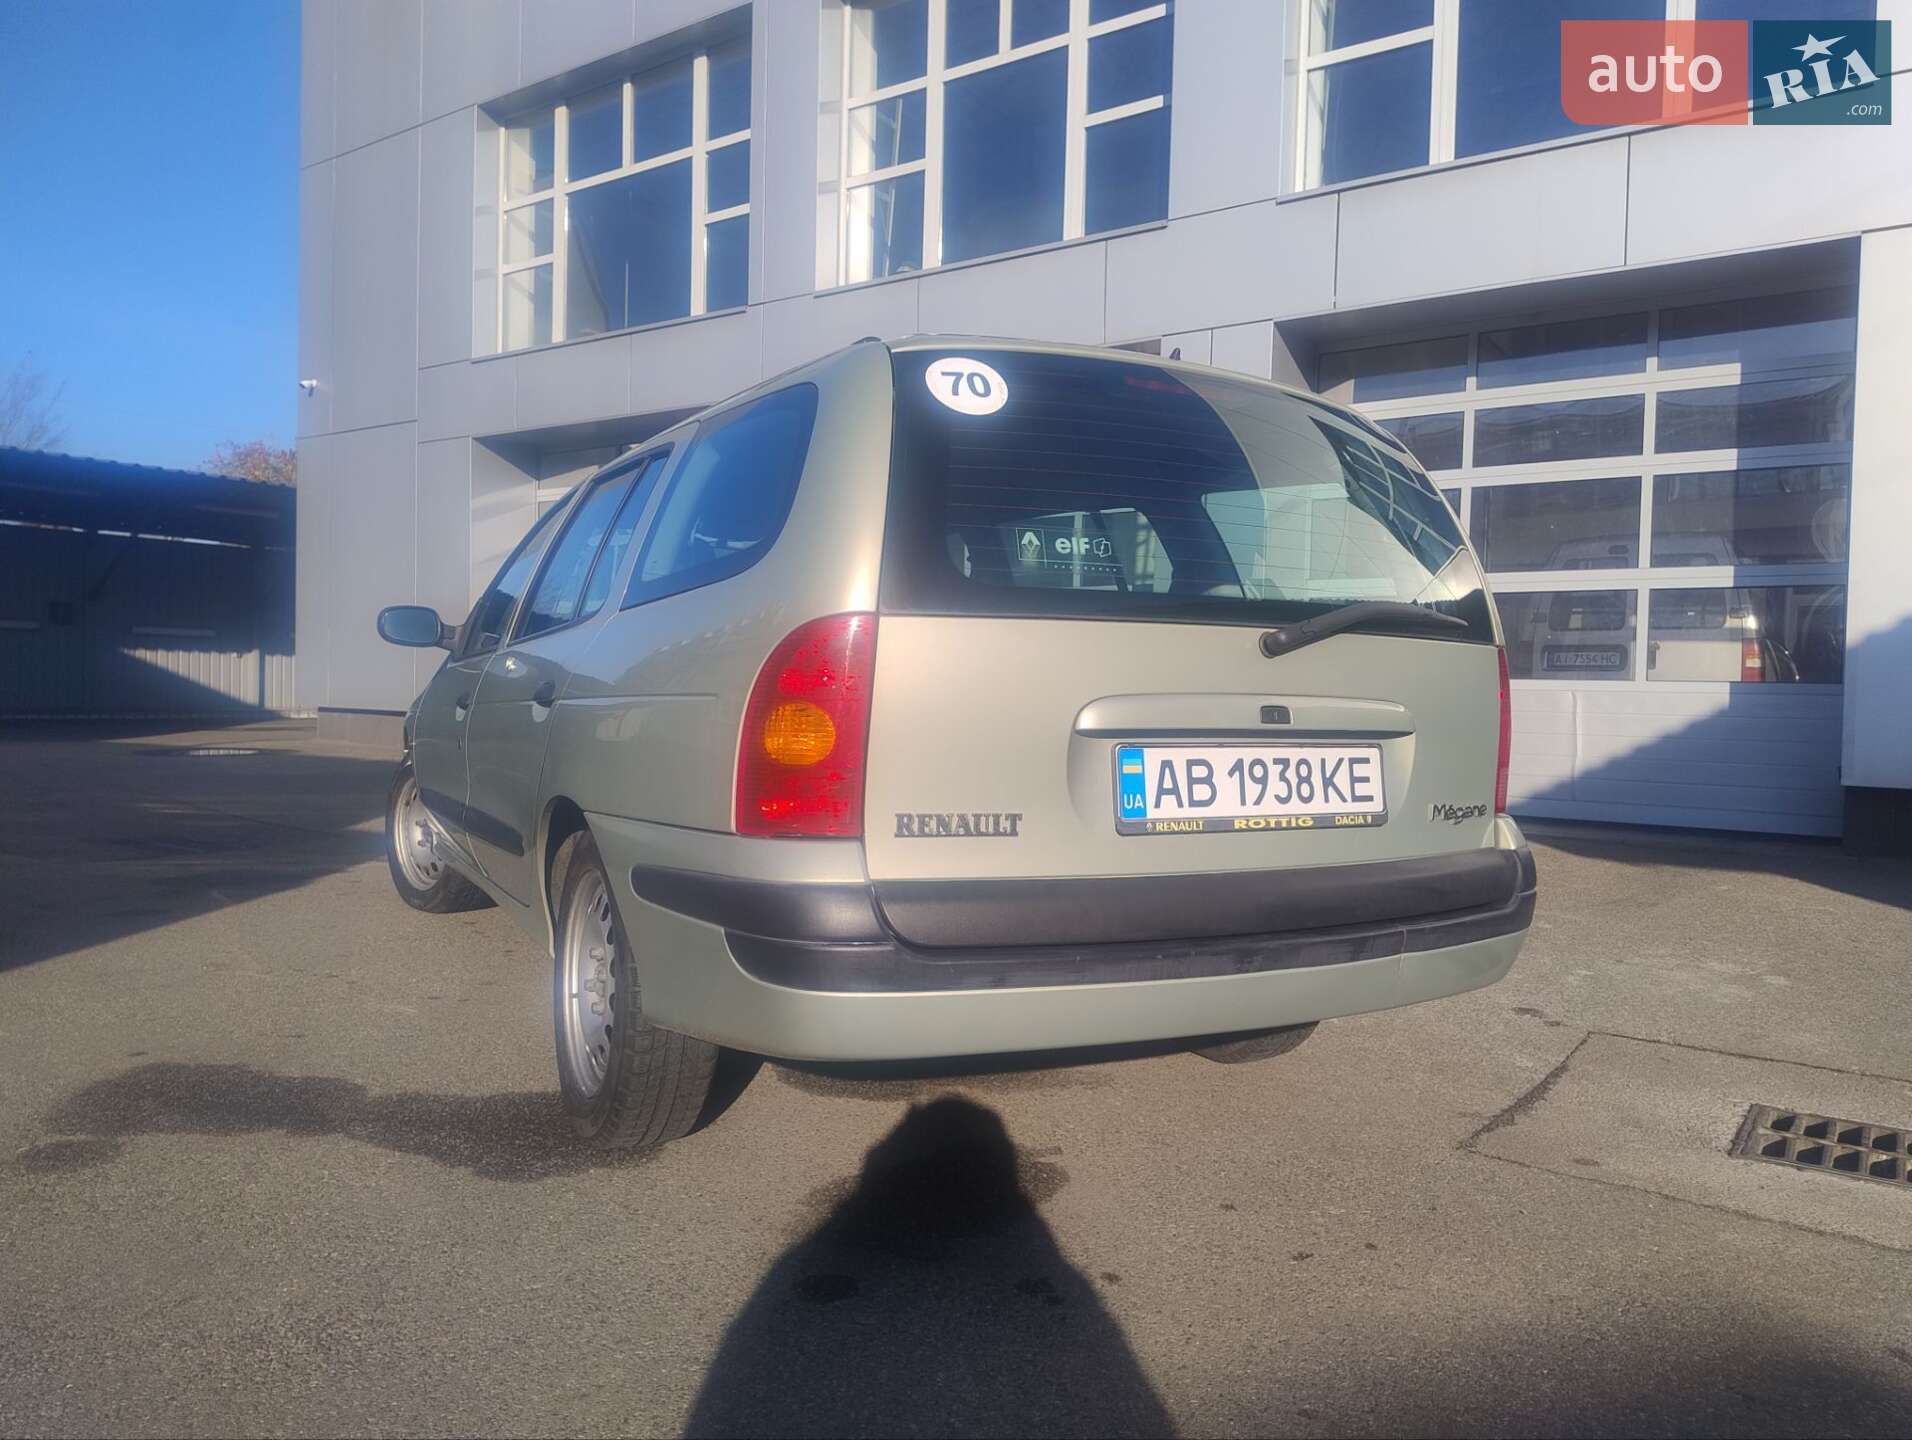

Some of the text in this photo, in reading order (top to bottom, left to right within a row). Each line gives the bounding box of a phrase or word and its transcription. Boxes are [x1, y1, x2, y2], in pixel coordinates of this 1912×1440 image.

[941, 371, 991, 398] 70
[1153, 758, 1217, 809] AB
[1124, 793, 1144, 809] UA
[894, 813, 1022, 838] RENAULT
[1155, 820, 1204, 832] RENAULT
[1335, 815, 1365, 827] DACIA
